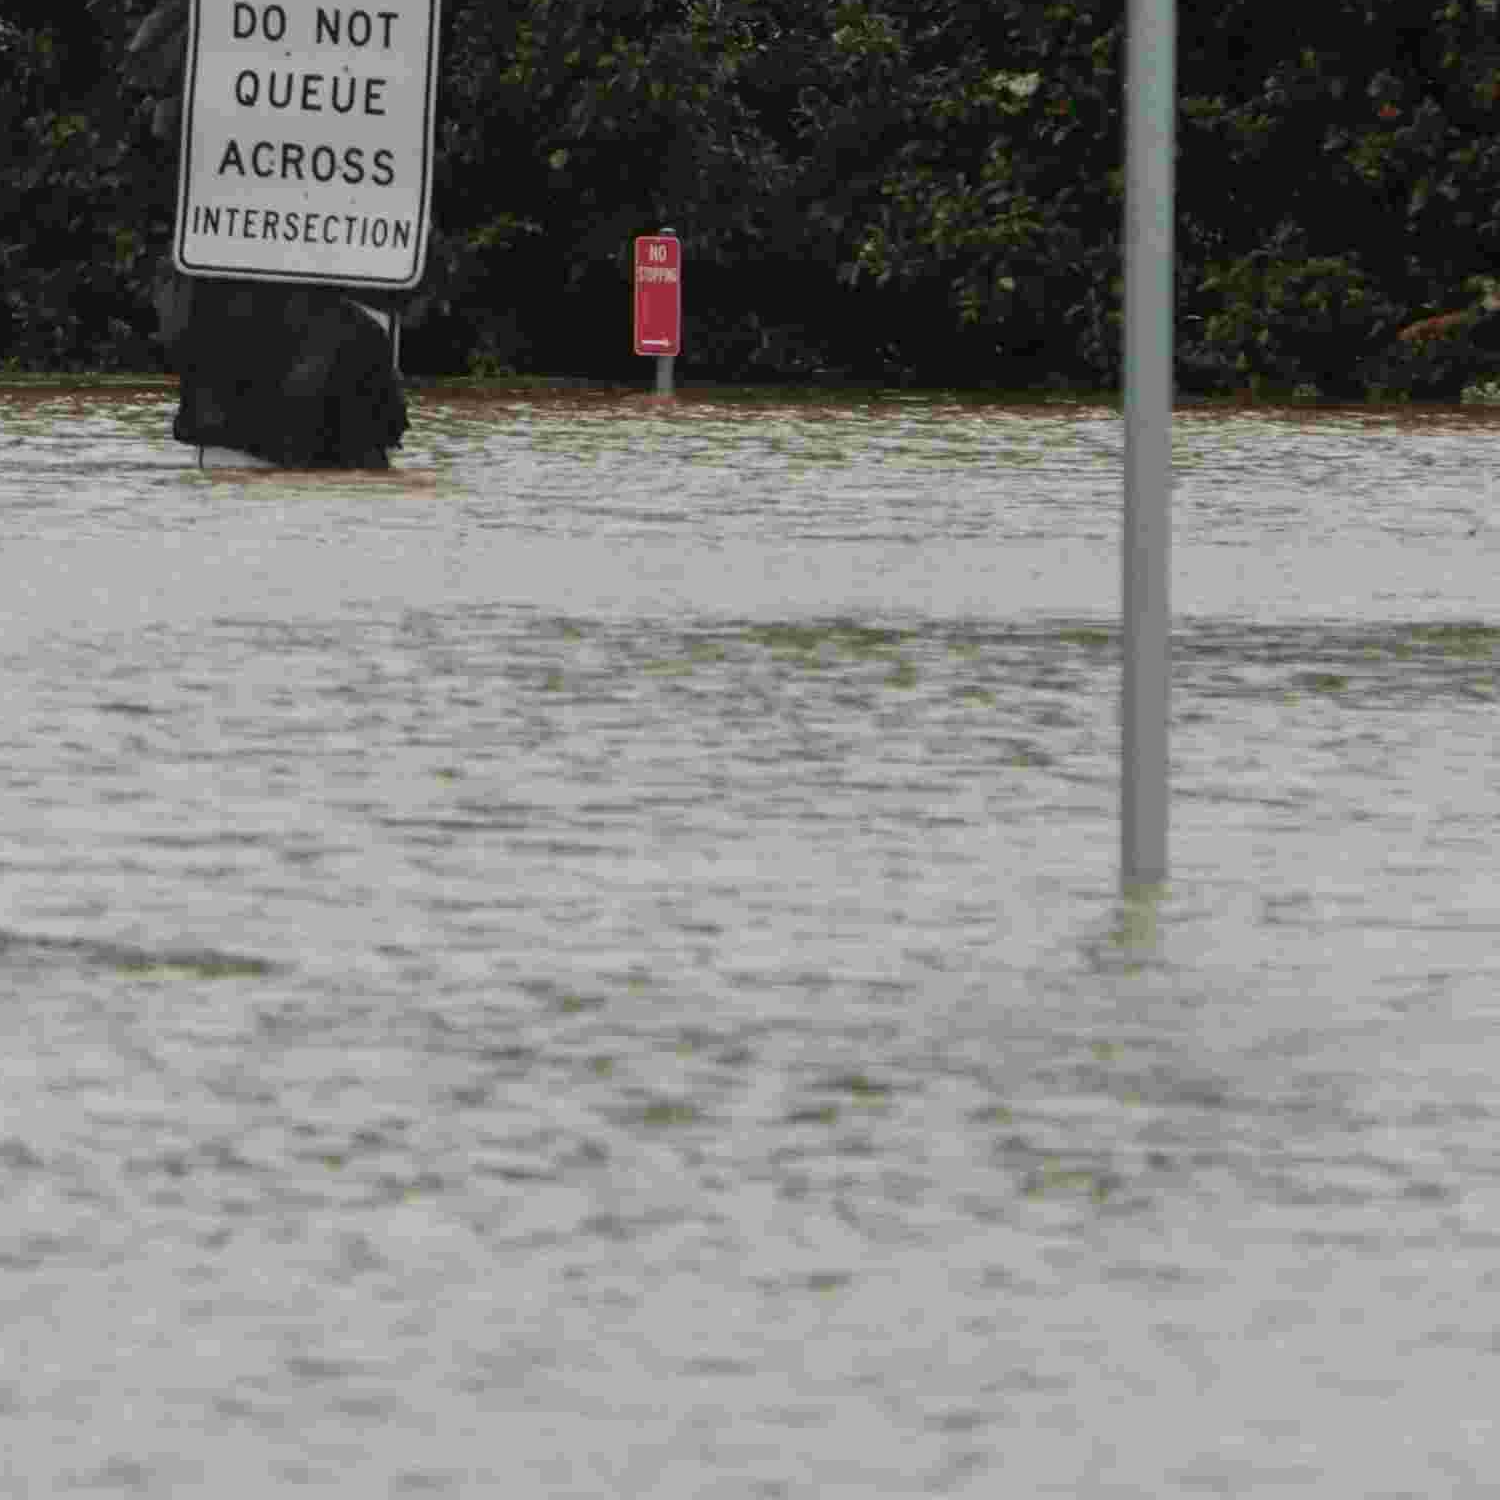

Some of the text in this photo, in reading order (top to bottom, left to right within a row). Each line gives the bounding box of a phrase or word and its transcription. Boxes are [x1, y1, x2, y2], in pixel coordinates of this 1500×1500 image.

[232, 2, 399, 48] DO NOT
[234, 69, 387, 116] QUEUE
[218, 139, 395, 186] ACROSS
[193, 205, 411, 249] INTERSECTION
